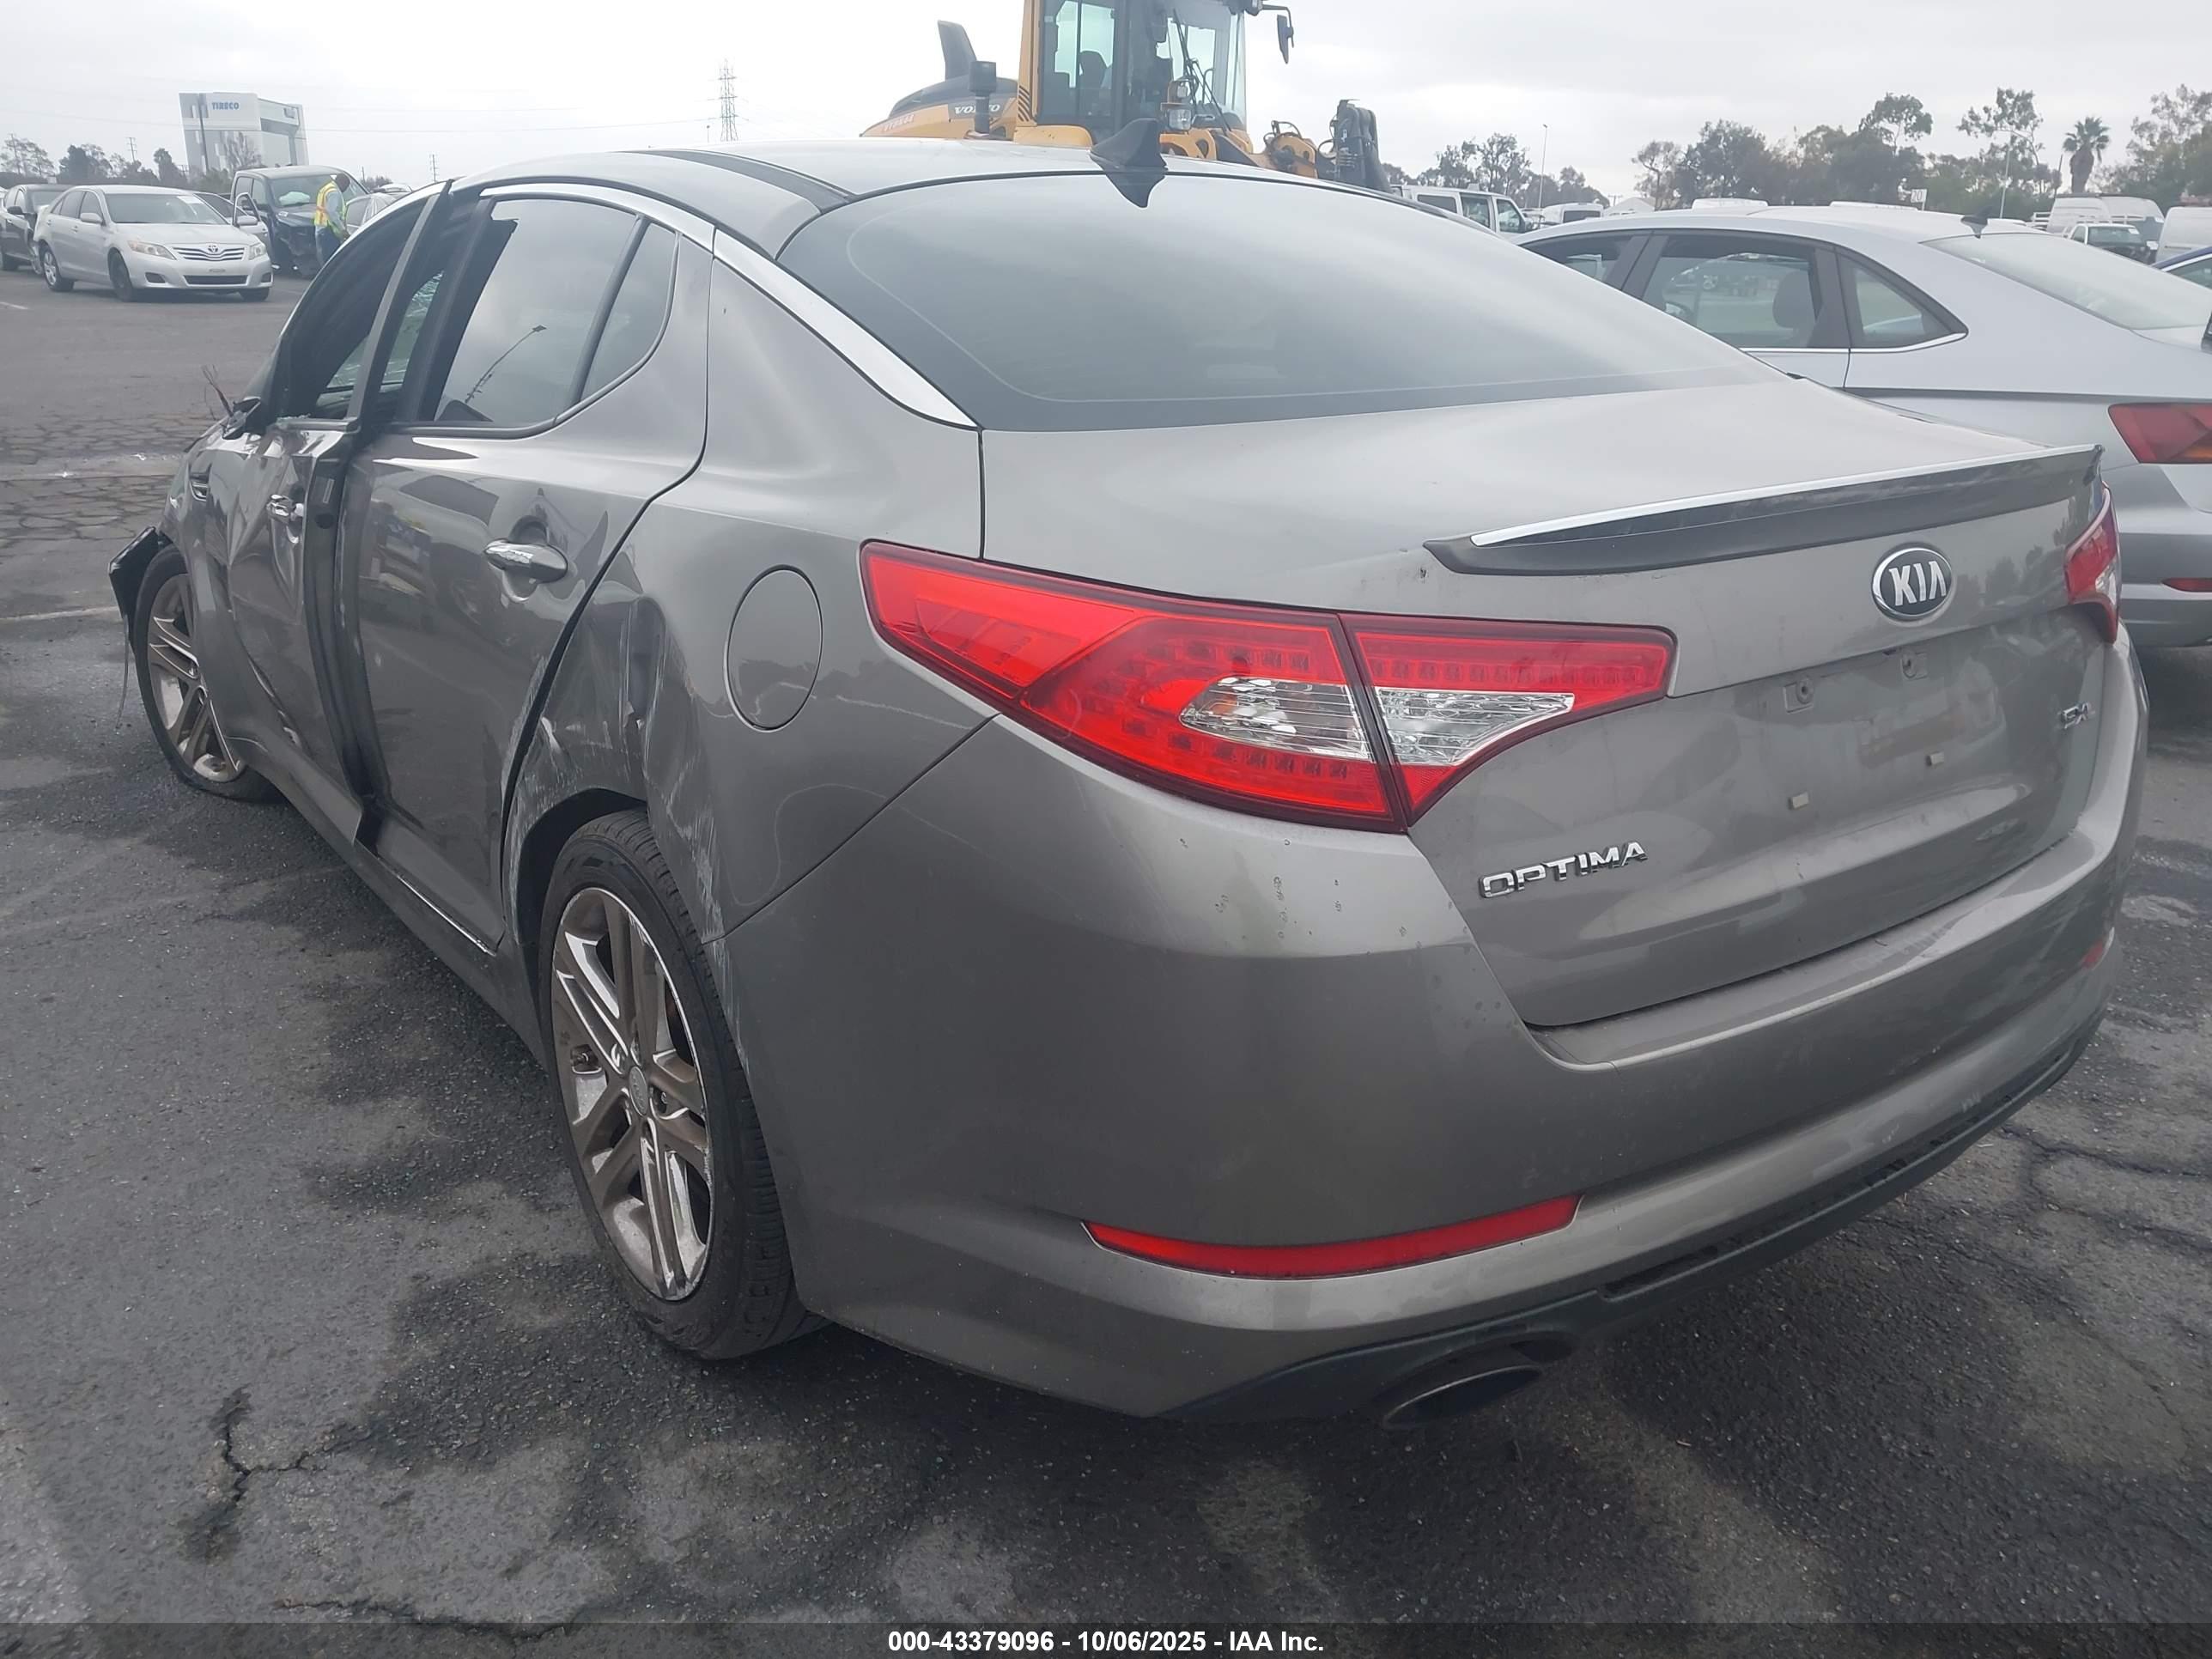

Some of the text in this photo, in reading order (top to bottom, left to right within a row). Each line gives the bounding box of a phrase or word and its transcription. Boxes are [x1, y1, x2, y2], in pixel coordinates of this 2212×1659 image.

[212, 101, 240, 110] TIRECO
[1888, 560, 1947, 606] KIA
[1480, 841, 1648, 898] OPTIMA
